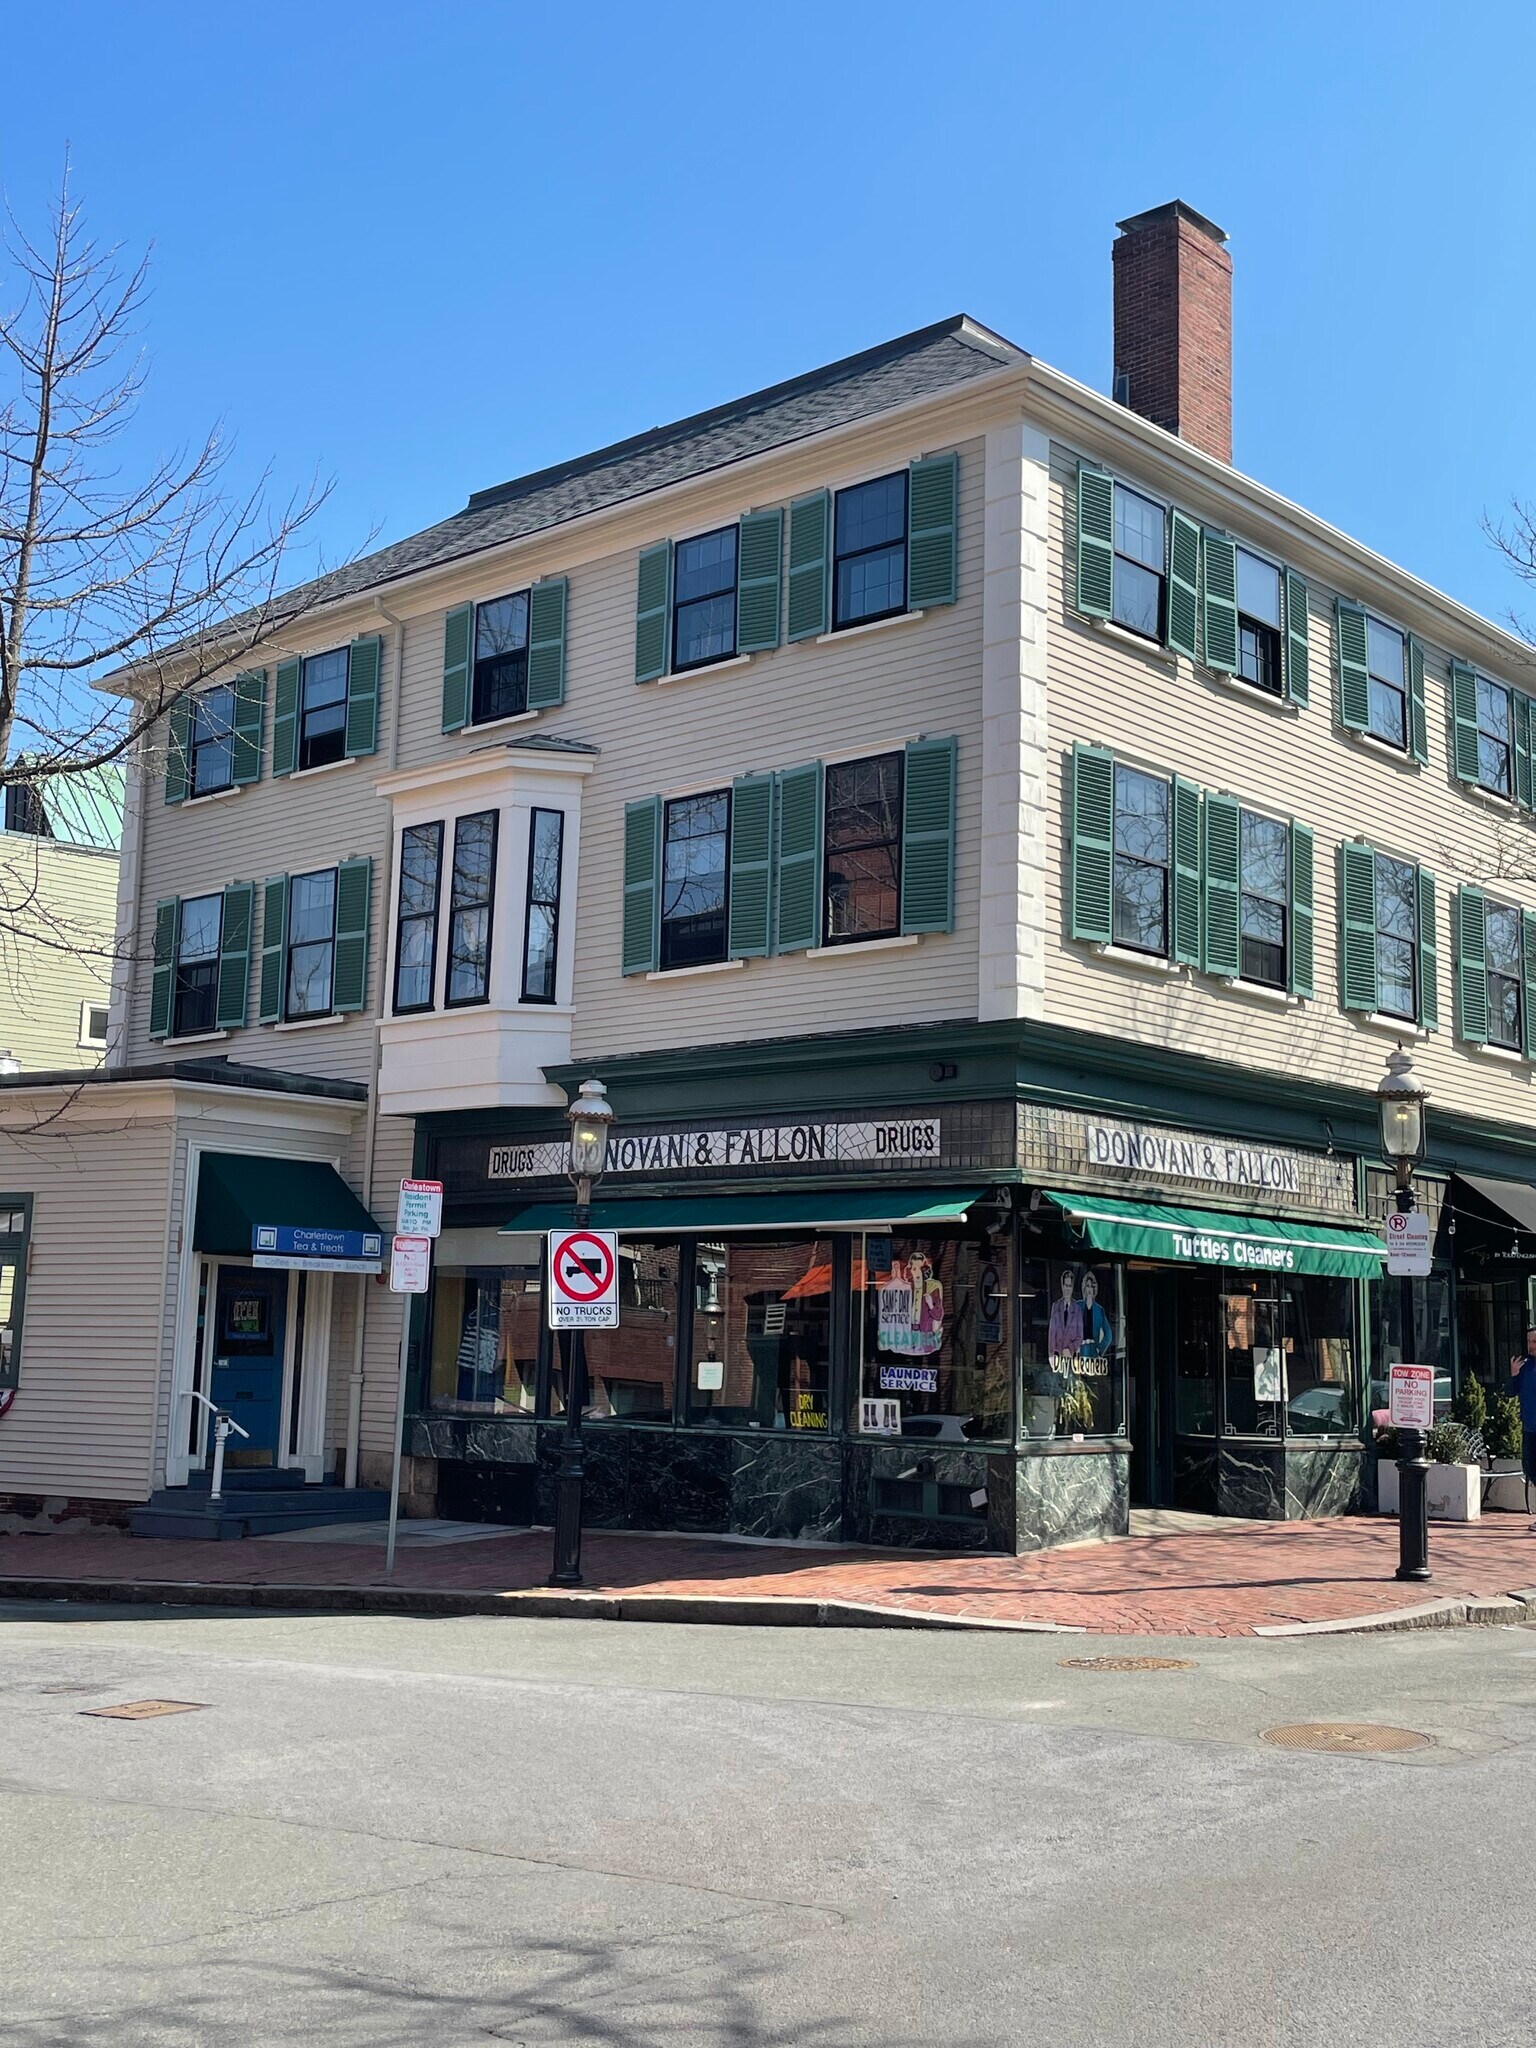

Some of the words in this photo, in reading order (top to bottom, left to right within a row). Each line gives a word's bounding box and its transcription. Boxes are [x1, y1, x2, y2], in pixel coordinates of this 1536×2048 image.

[695, 1133, 712, 1165] &
[725, 1125, 826, 1164] FALLON
[876, 1125, 934, 1153] DRUGS
[492, 1149, 535, 1174] DRUGS
[1094, 1128, 1195, 1175] DONOVAN
[1204, 1145, 1217, 1179] &
[1225, 1149, 1294, 1190] FALLON
[293, 1229, 345, 1241] Charlestown
[1406, 1233, 1428, 1241] Cleaning
[293, 1241, 309, 1251] Tea
[311, 1243, 318, 1252] &
[320, 1243, 344, 1253] Treats
[1172, 1233, 1230, 1261] Tuttles
[1233, 1241, 1294, 1269] Cleaners
[264, 1257, 290, 1265] Coffee
[345, 1262, 368, 1270] Lunch
[881, 1289, 898, 1313] SAME
[898, 1289, 911, 1313] DAY
[556, 1306, 571, 1315] NO
[574, 1306, 612, 1316] TRUCKS
[881, 1367, 937, 1381] LAUNDRY
[1393, 1369, 1409, 1377] TOW
[1410, 1371, 1430, 1379] ZONE
[881, 1379, 937, 1391] SERVICE
[1404, 1380, 1418, 1389] NO
[1395, 1388, 1428, 1397] PARKING
[798, 1393, 814, 1410] DRY
[789, 1411, 828, 1429] CLEANING
